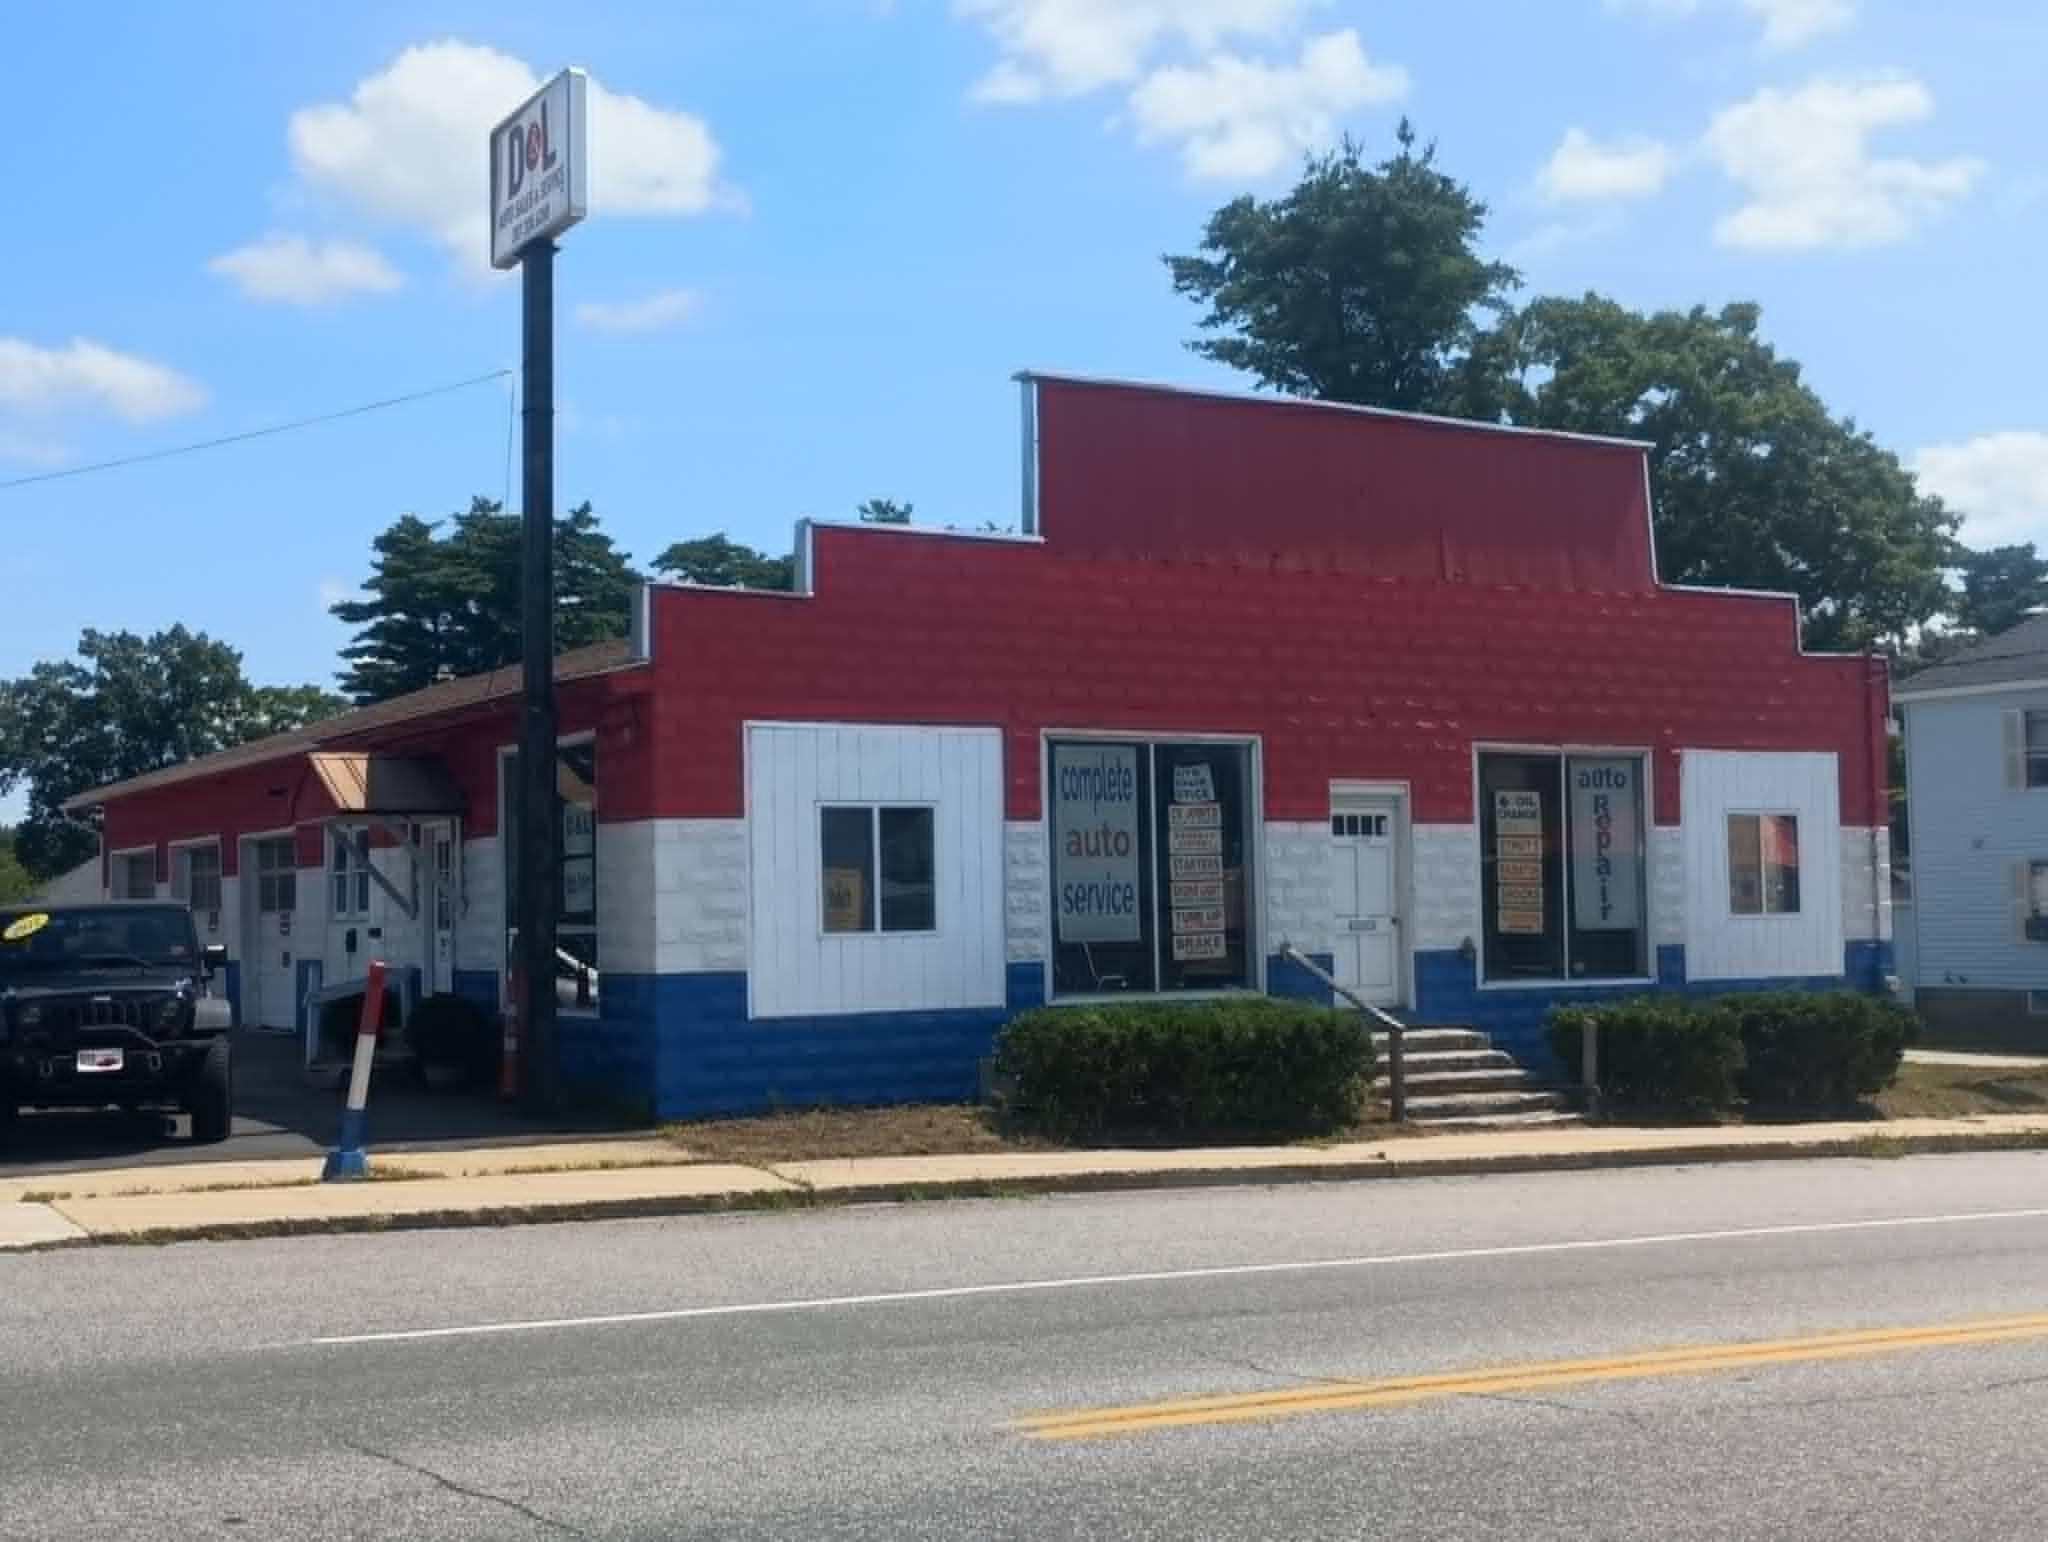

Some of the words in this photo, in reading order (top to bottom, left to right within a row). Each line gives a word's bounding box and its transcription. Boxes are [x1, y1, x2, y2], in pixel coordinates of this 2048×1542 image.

[1062, 752, 1134, 816] complete
[1578, 767, 1627, 789] auto
[1065, 819, 1131, 857] auto
[1593, 794, 1615, 921] Repair
[1062, 872, 1135, 914] service
